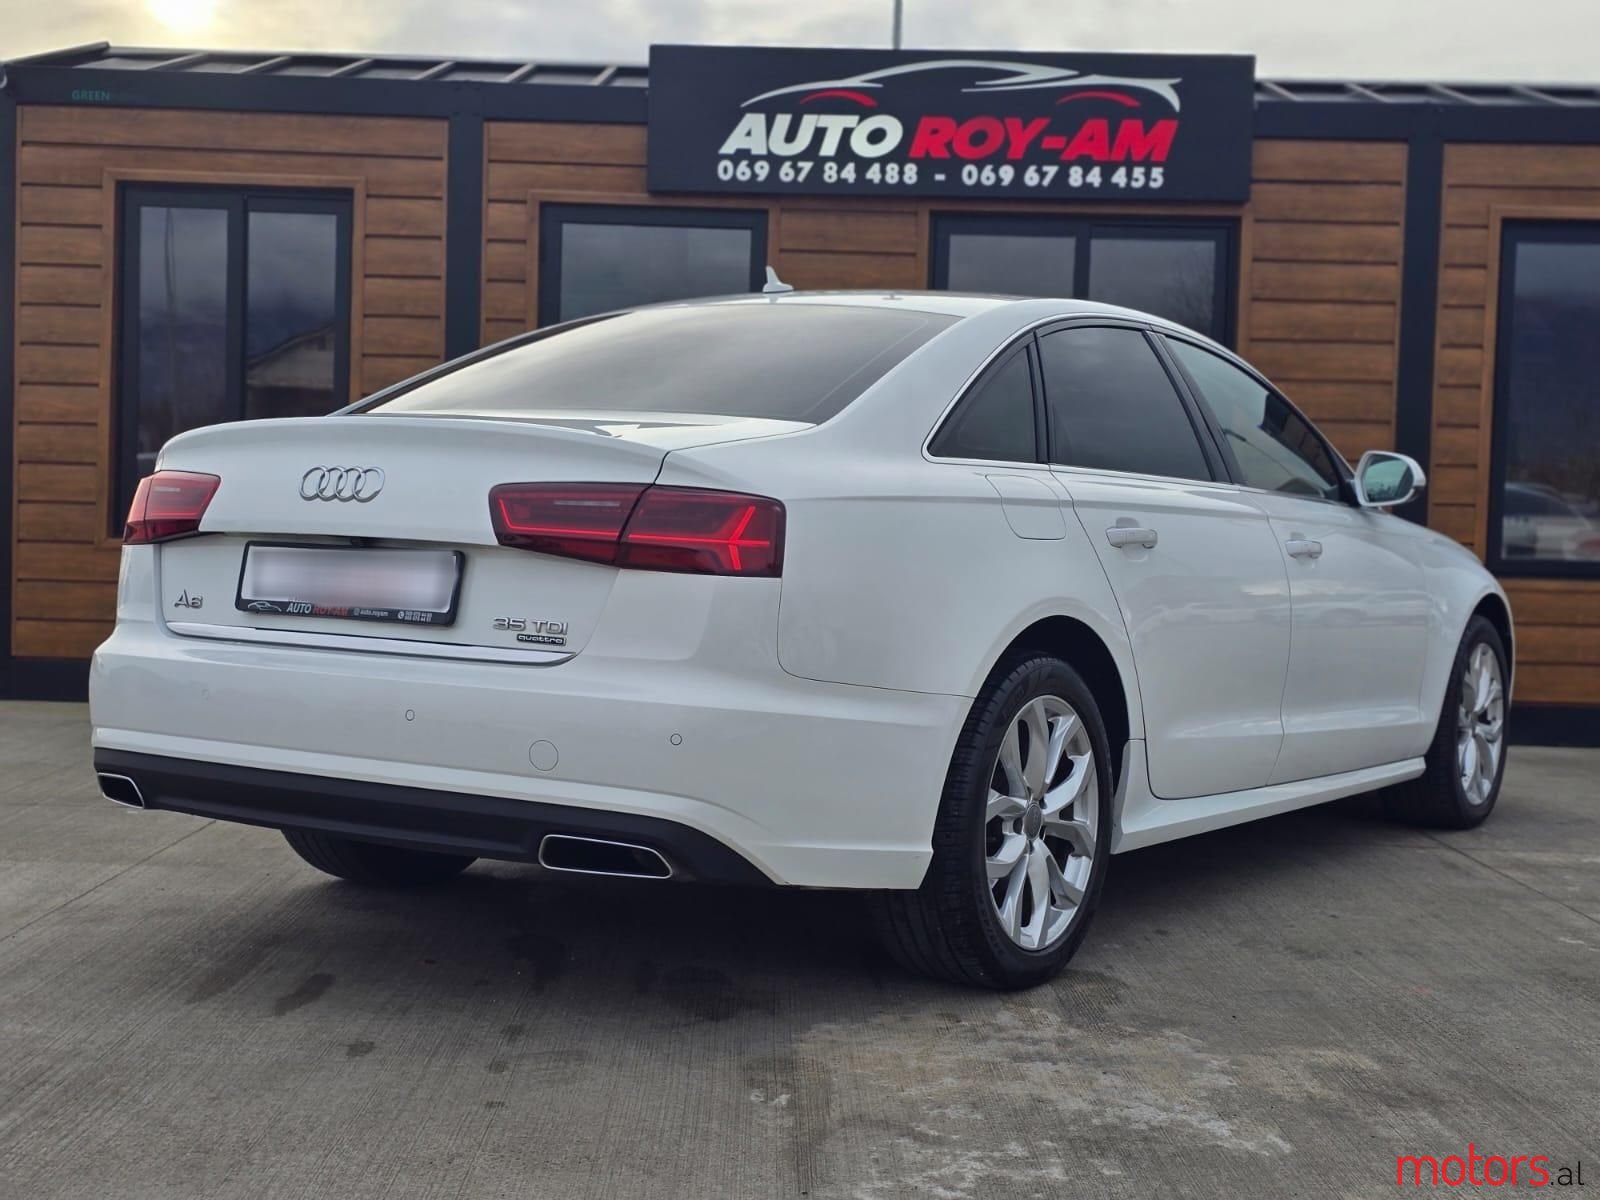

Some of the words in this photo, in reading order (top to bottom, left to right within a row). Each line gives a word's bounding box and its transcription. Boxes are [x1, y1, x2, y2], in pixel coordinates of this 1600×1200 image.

[71, 88, 111, 101] GREEN
[718, 112, 904, 158] AUTO
[908, 115, 1179, 162] ROY-AM
[717, 159, 770, 181] 069
[779, 160, 814, 183] 67
[823, 162, 857, 184] 84
[865, 162, 918, 185] 488
[961, 164, 1015, 186] 069
[1023, 165, 1060, 187] 67
[1068, 166, 1102, 188] 84
[1111, 166, 1164, 189] 455
[286, 602, 312, 614] AUTO
[493, 616, 527, 632] 35
[531, 620, 569, 635] TDI
[517, 634, 564, 645] quattro
